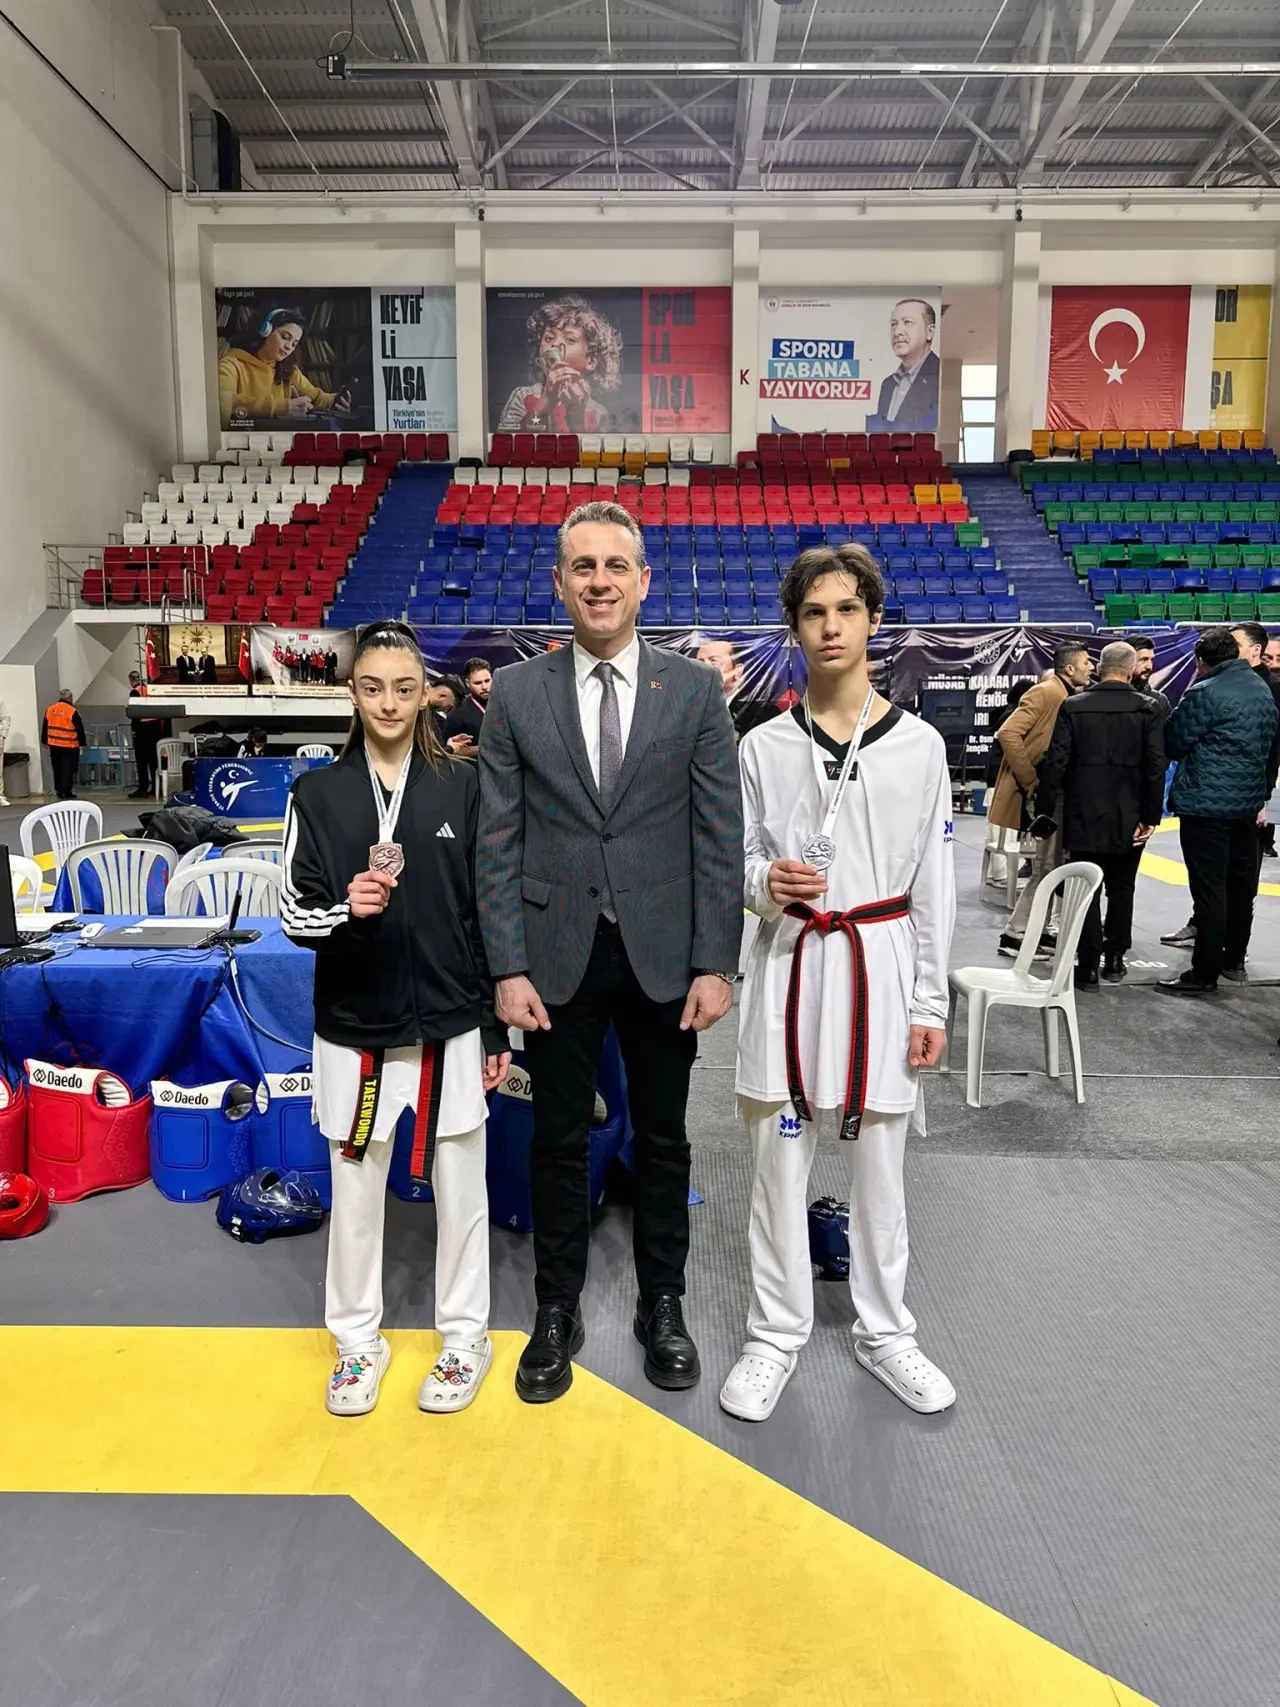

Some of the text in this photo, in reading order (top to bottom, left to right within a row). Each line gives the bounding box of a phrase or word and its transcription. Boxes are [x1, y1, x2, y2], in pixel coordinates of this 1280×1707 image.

[649, 330, 672, 364] LA
[779, 340, 844, 359] SPORU
[740, 369, 750, 385] K
[774, 360, 852, 379] TABANA
[382, 365, 427, 404] YAŞA
[762, 380, 870, 399] YAYIYORUZ
[648, 375, 696, 414] YAŞA
[968, 735, 994, 744] Dr. Osm
[47, 1070, 83, 1090] Daedo
[174, 1090, 209, 1106] Daedo
[353, 1079, 377, 1146] TAEKWONDO
[48, 1187, 55, 1199] 3
[412, 1186, 420, 1198] 2
[509, 1214, 518, 1227] 4
